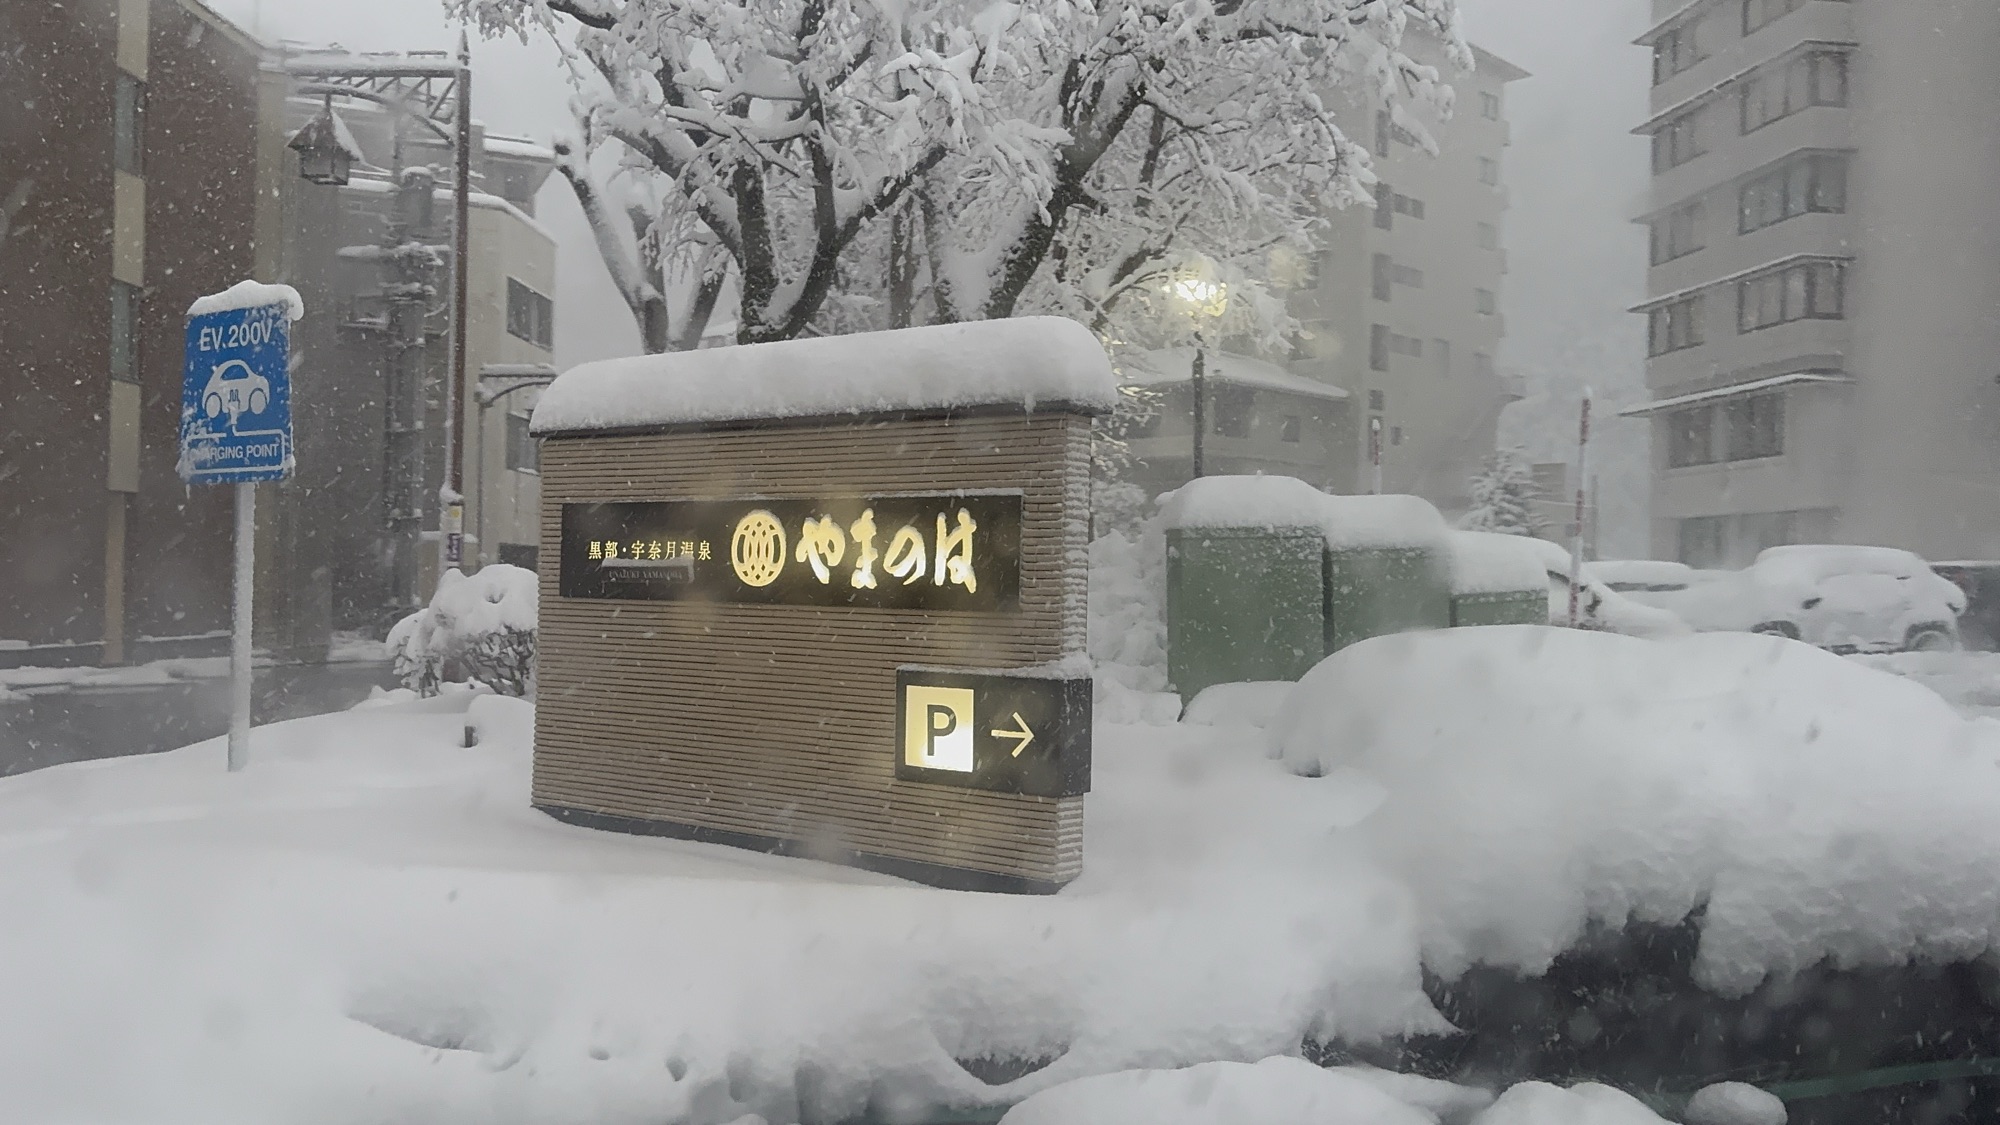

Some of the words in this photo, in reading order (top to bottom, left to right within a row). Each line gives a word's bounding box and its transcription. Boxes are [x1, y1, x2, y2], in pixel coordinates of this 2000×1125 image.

[246, 443, 280, 458] POINT
[795, 507, 978, 594] やまのは
[926, 704, 957, 757] P
